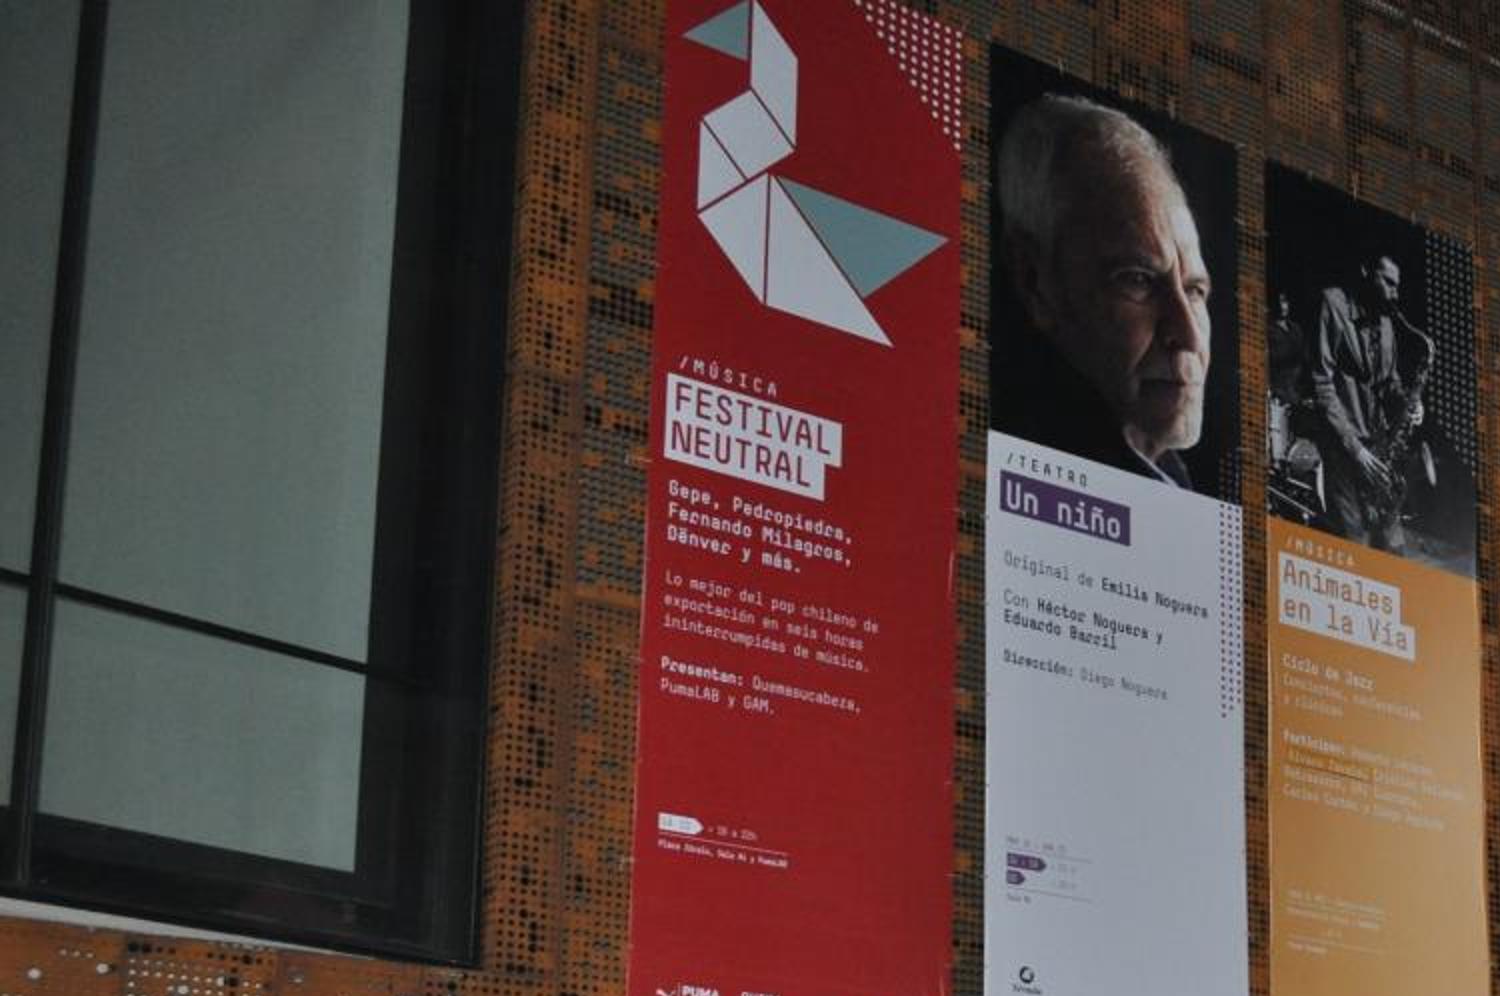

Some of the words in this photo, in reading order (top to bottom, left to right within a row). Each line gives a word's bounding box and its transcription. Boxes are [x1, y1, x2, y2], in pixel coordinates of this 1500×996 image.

[679, 355, 777, 397] /MÚSICA
[674, 381, 831, 455] FESTIVAL
[671, 421, 811, 487] NEUTRAL
[1007, 452, 1088, 487] /TEATRO
[669, 480, 720, 511] Gepe,
[1005, 479, 1039, 515] Un
[1057, 502, 1121, 539] niño
[669, 502, 752, 538] Fernando
[762, 529, 852, 567] Milagros,
[1004, 550, 1069, 583] Original
[1283, 559, 1394, 615] Animales
[1283, 598, 1311, 625] en
[1327, 605, 1353, 636] la
[1368, 617, 1408, 651] Vía
